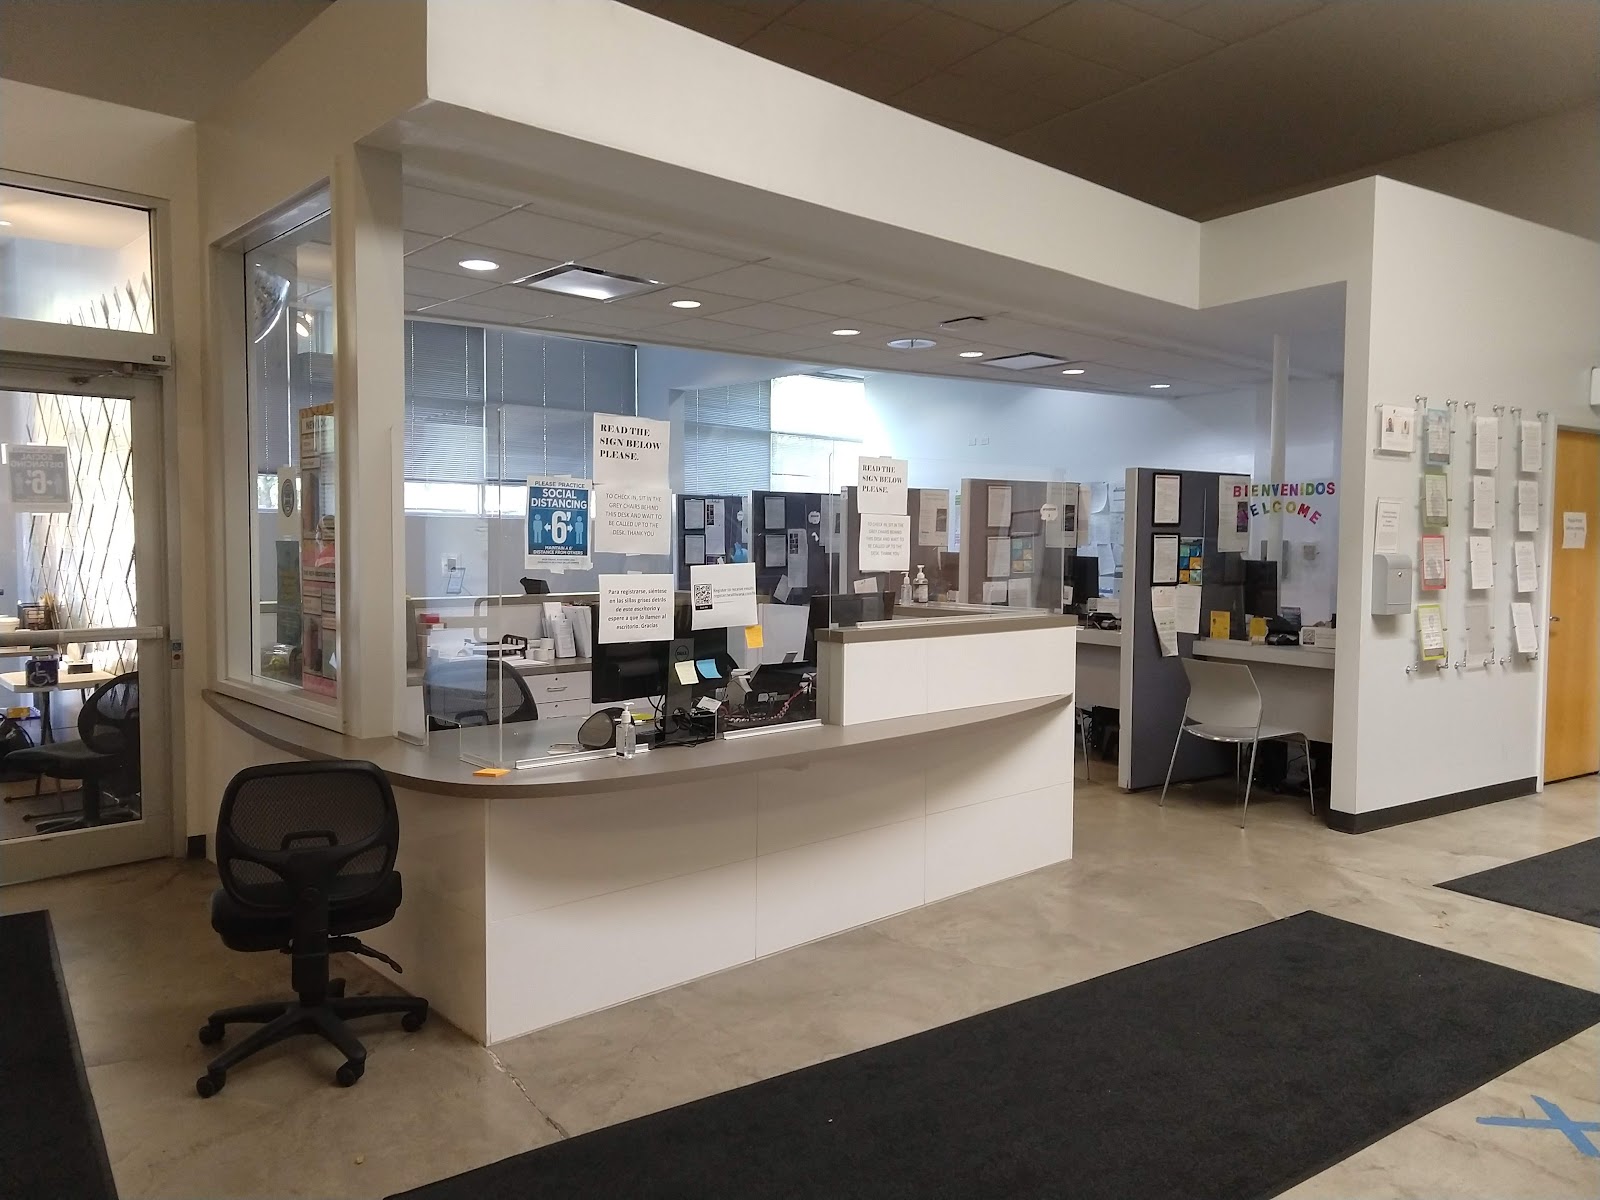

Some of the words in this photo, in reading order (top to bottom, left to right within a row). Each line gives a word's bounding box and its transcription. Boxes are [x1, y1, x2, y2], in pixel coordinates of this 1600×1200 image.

[600, 423, 628, 435] READ
[629, 425, 651, 437] THE
[599, 437, 626, 449] SIGN
[626, 438, 662, 450] BELOW
[600, 450, 639, 461] PLEASE.
[862, 464, 882, 472] READ
[882, 465, 896, 473] THE
[880, 476, 902, 484] BELOW
[558, 481, 585, 489] PRACTICE
[862, 485, 889, 494] PLEASE.
[1233, 482, 1336, 497] BIENVENIDOS
[542, 489, 577, 499] SOCIAL
[531, 498, 587, 510] DISTANCING
[622, 502, 641, 510] CHAIRS
[551, 510, 571, 544] 6'
[637, 597, 651, 605] grises
[608, 615, 625, 623] espere
[629, 615, 639, 623] que
